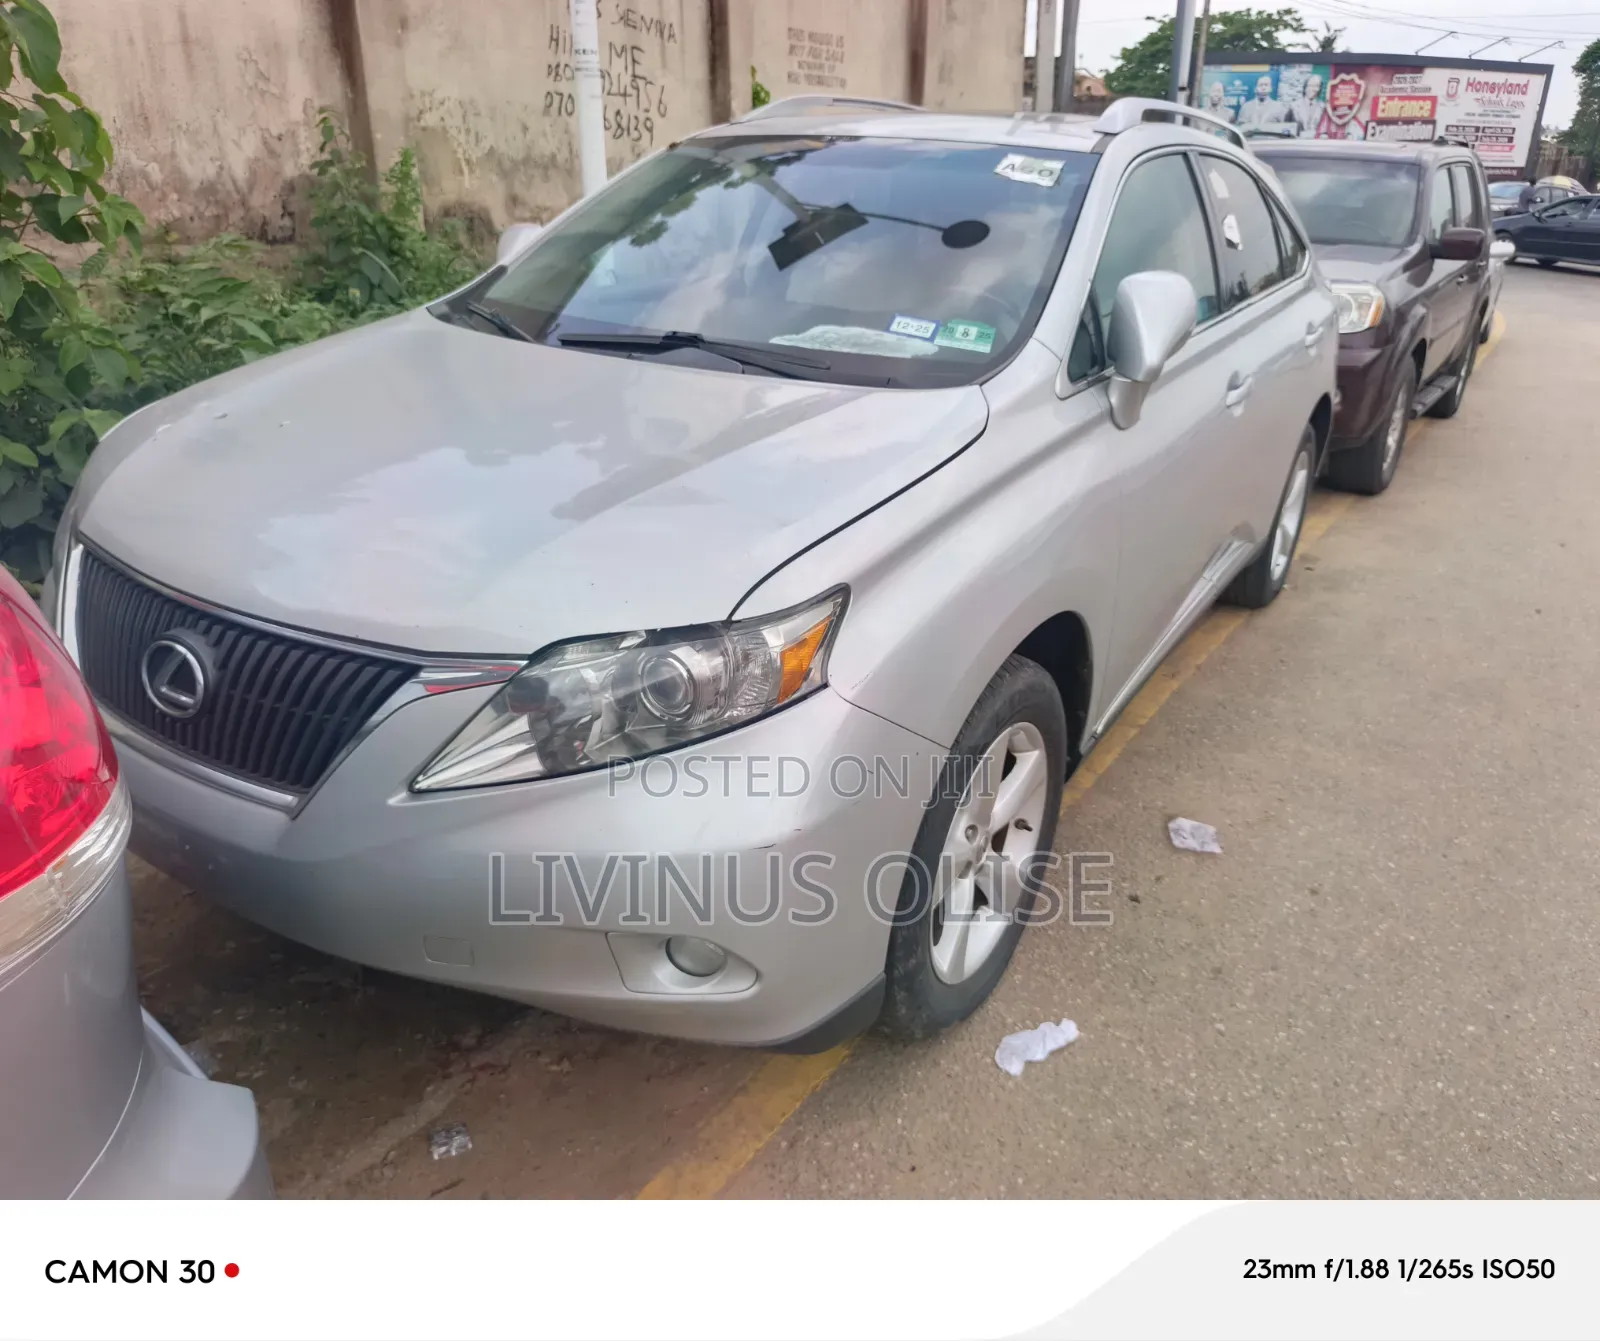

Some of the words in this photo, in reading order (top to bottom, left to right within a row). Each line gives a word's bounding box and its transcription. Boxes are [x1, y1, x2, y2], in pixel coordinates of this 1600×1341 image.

[607, 41, 647, 84] ME
[1465, 77, 1530, 99] Honeyland
[544, 91, 575, 117] 070
[1377, 96, 1432, 118] Entrance
[1366, 121, 1433, 141] Examination
